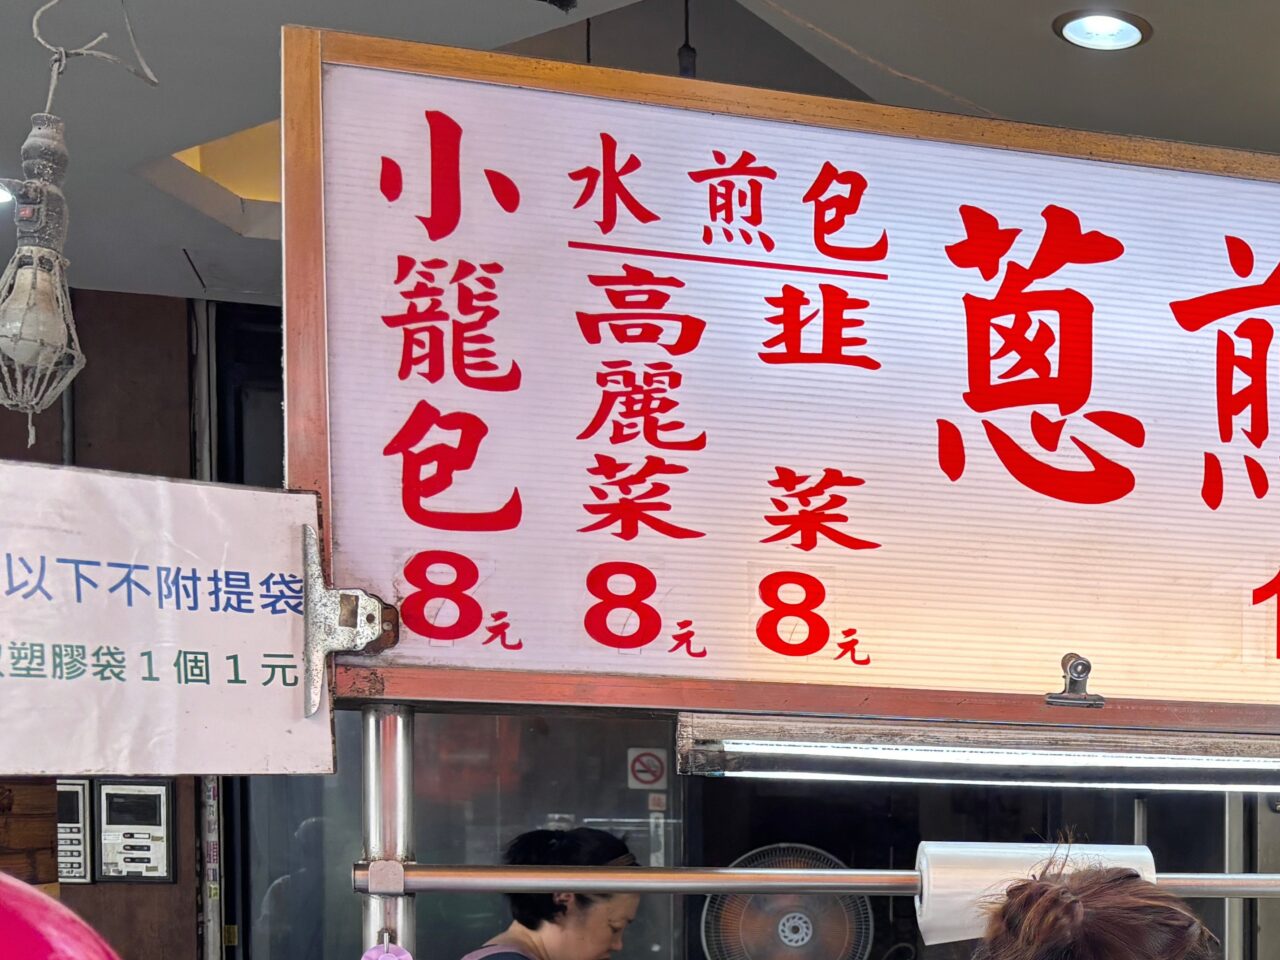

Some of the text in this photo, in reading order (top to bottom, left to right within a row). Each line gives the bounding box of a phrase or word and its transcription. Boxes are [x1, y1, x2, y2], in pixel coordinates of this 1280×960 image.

[567, 132, 889, 261] 水煎包
[379, 110, 523, 533] 小籠包
[575, 263, 707, 541] 高麗菜
[757, 283, 882, 552] 韭菜
[0, 640, 300, 687] 塑膠袋1個1元
[4, 553, 304, 616] 以下不附提袋
